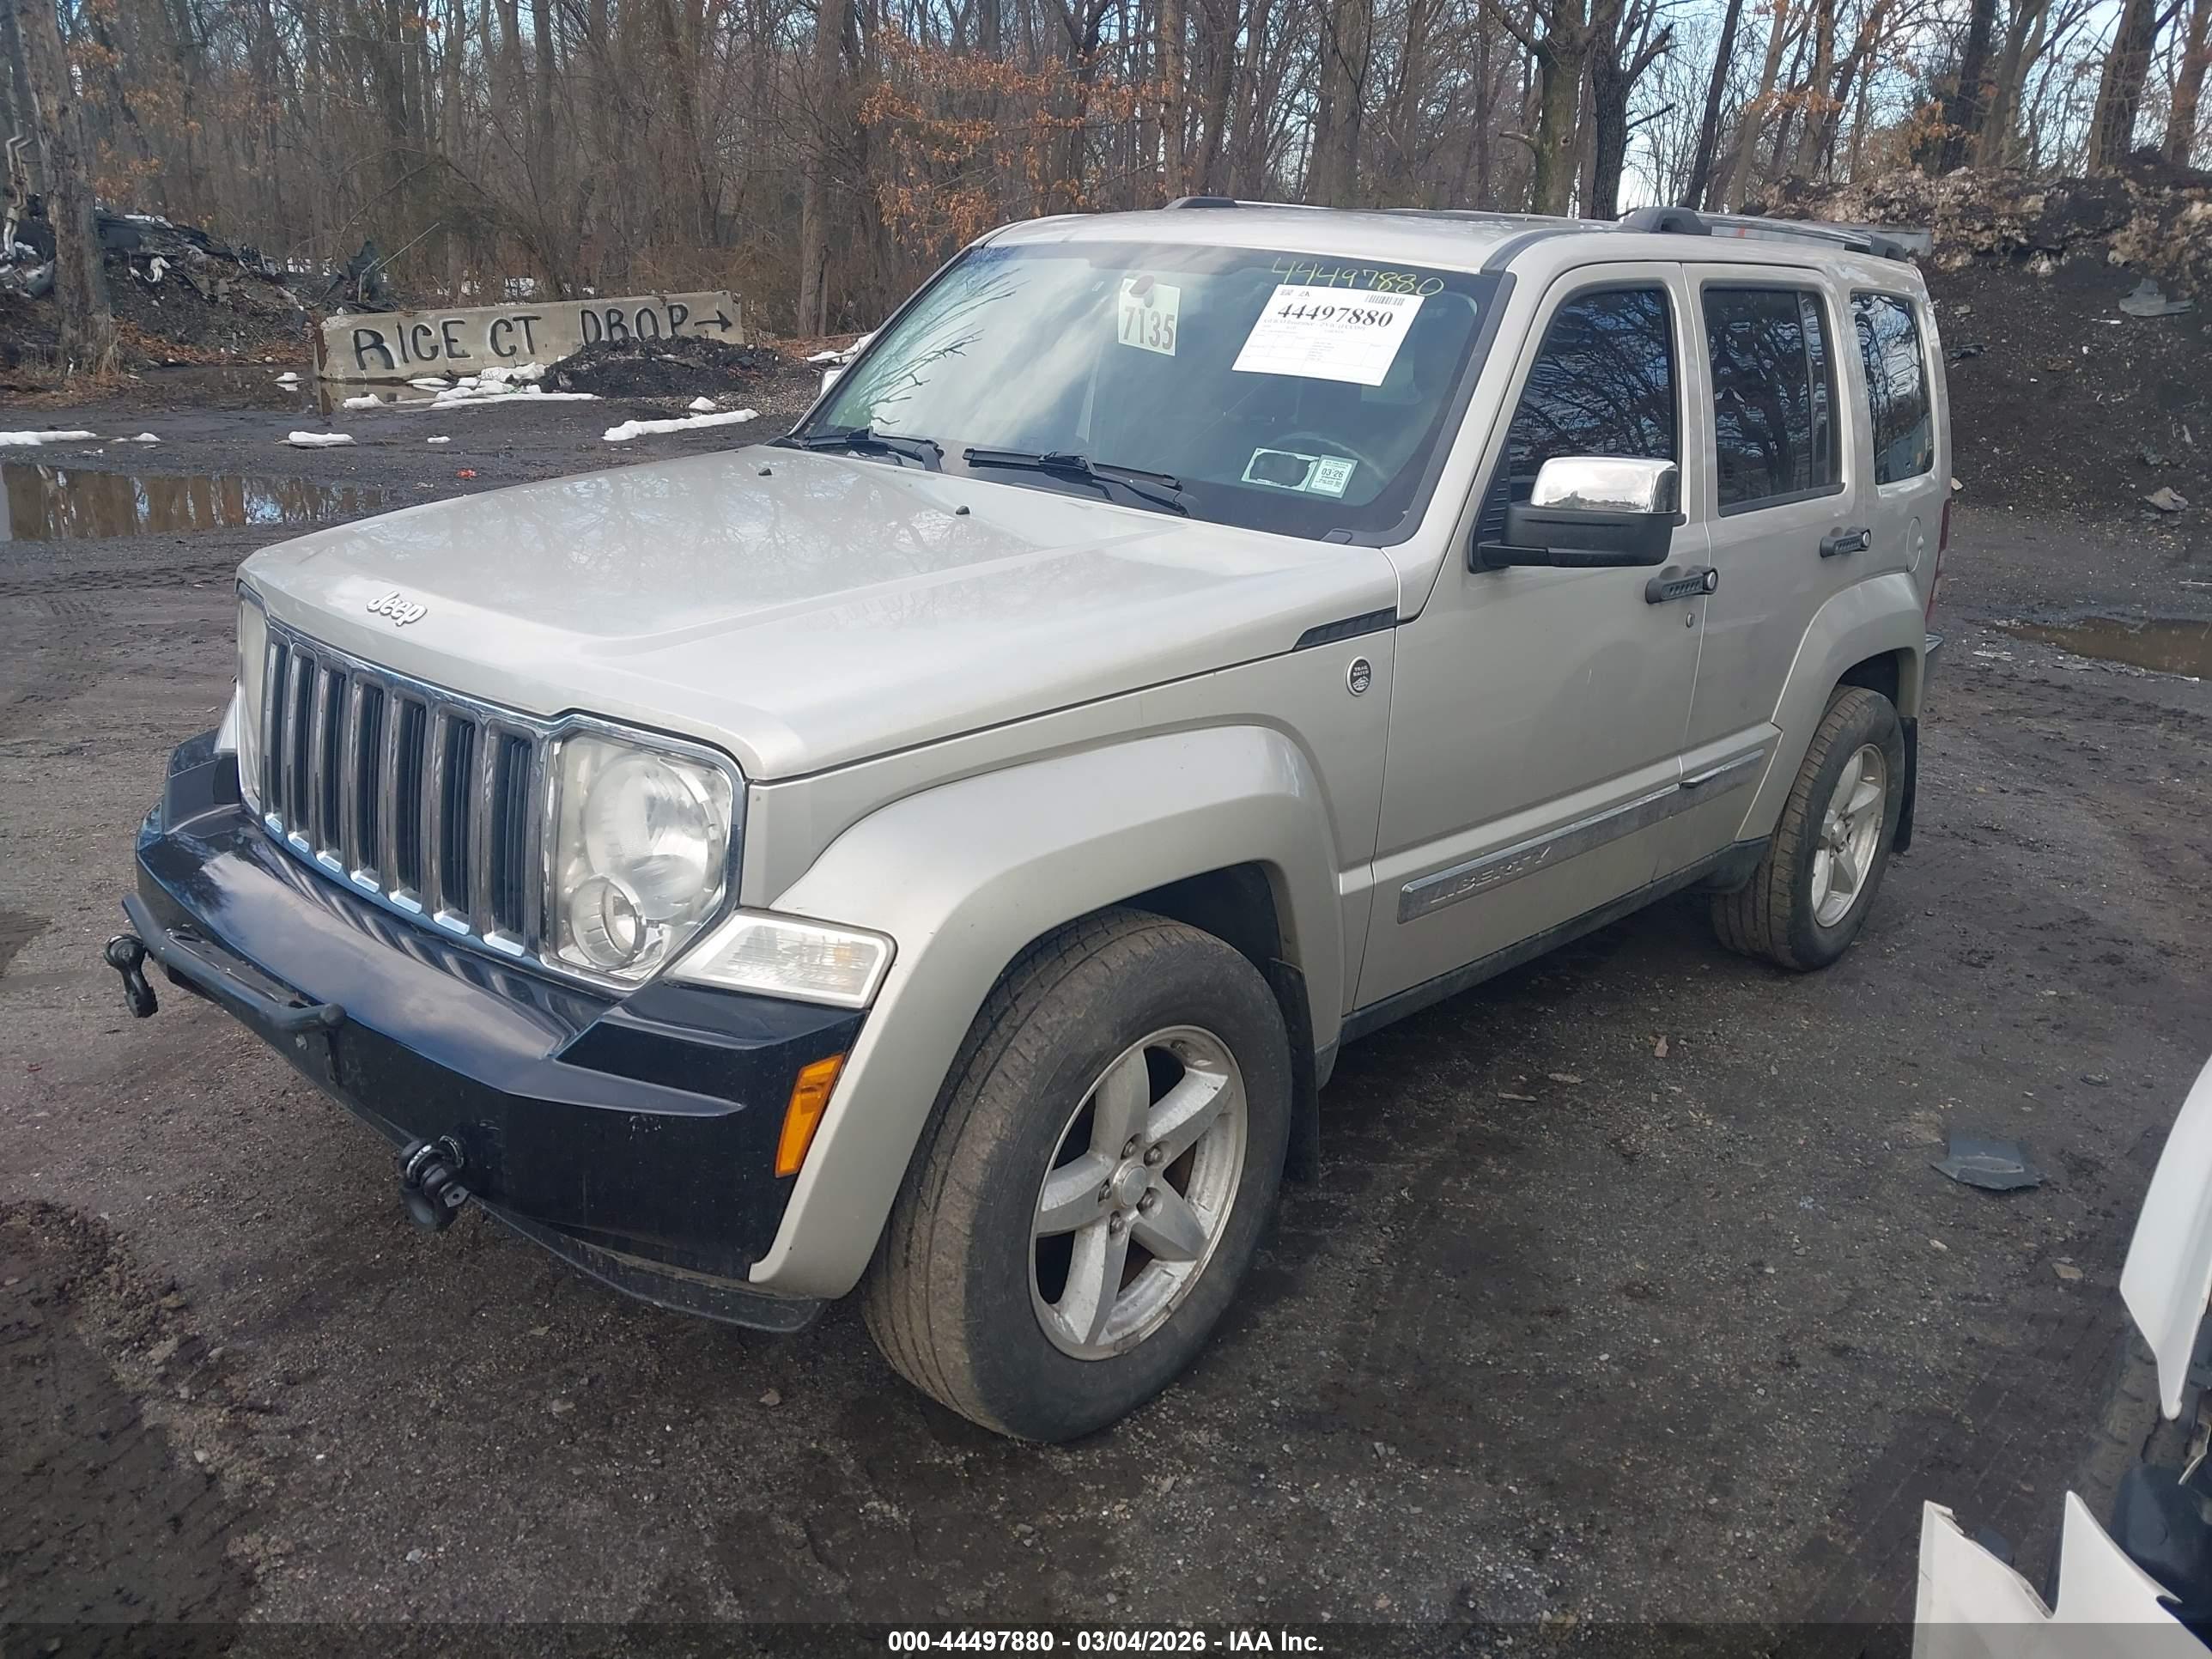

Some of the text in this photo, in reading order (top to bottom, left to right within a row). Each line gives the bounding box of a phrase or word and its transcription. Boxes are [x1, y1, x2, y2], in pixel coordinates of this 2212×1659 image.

[1272, 258, 1444, 296] 44497880
[1123, 305, 1176, 350] 7135
[1278, 303, 1394, 327] 44497880
[353, 303, 689, 371] RICE CT DROP
[367, 591, 428, 627] Jeep
